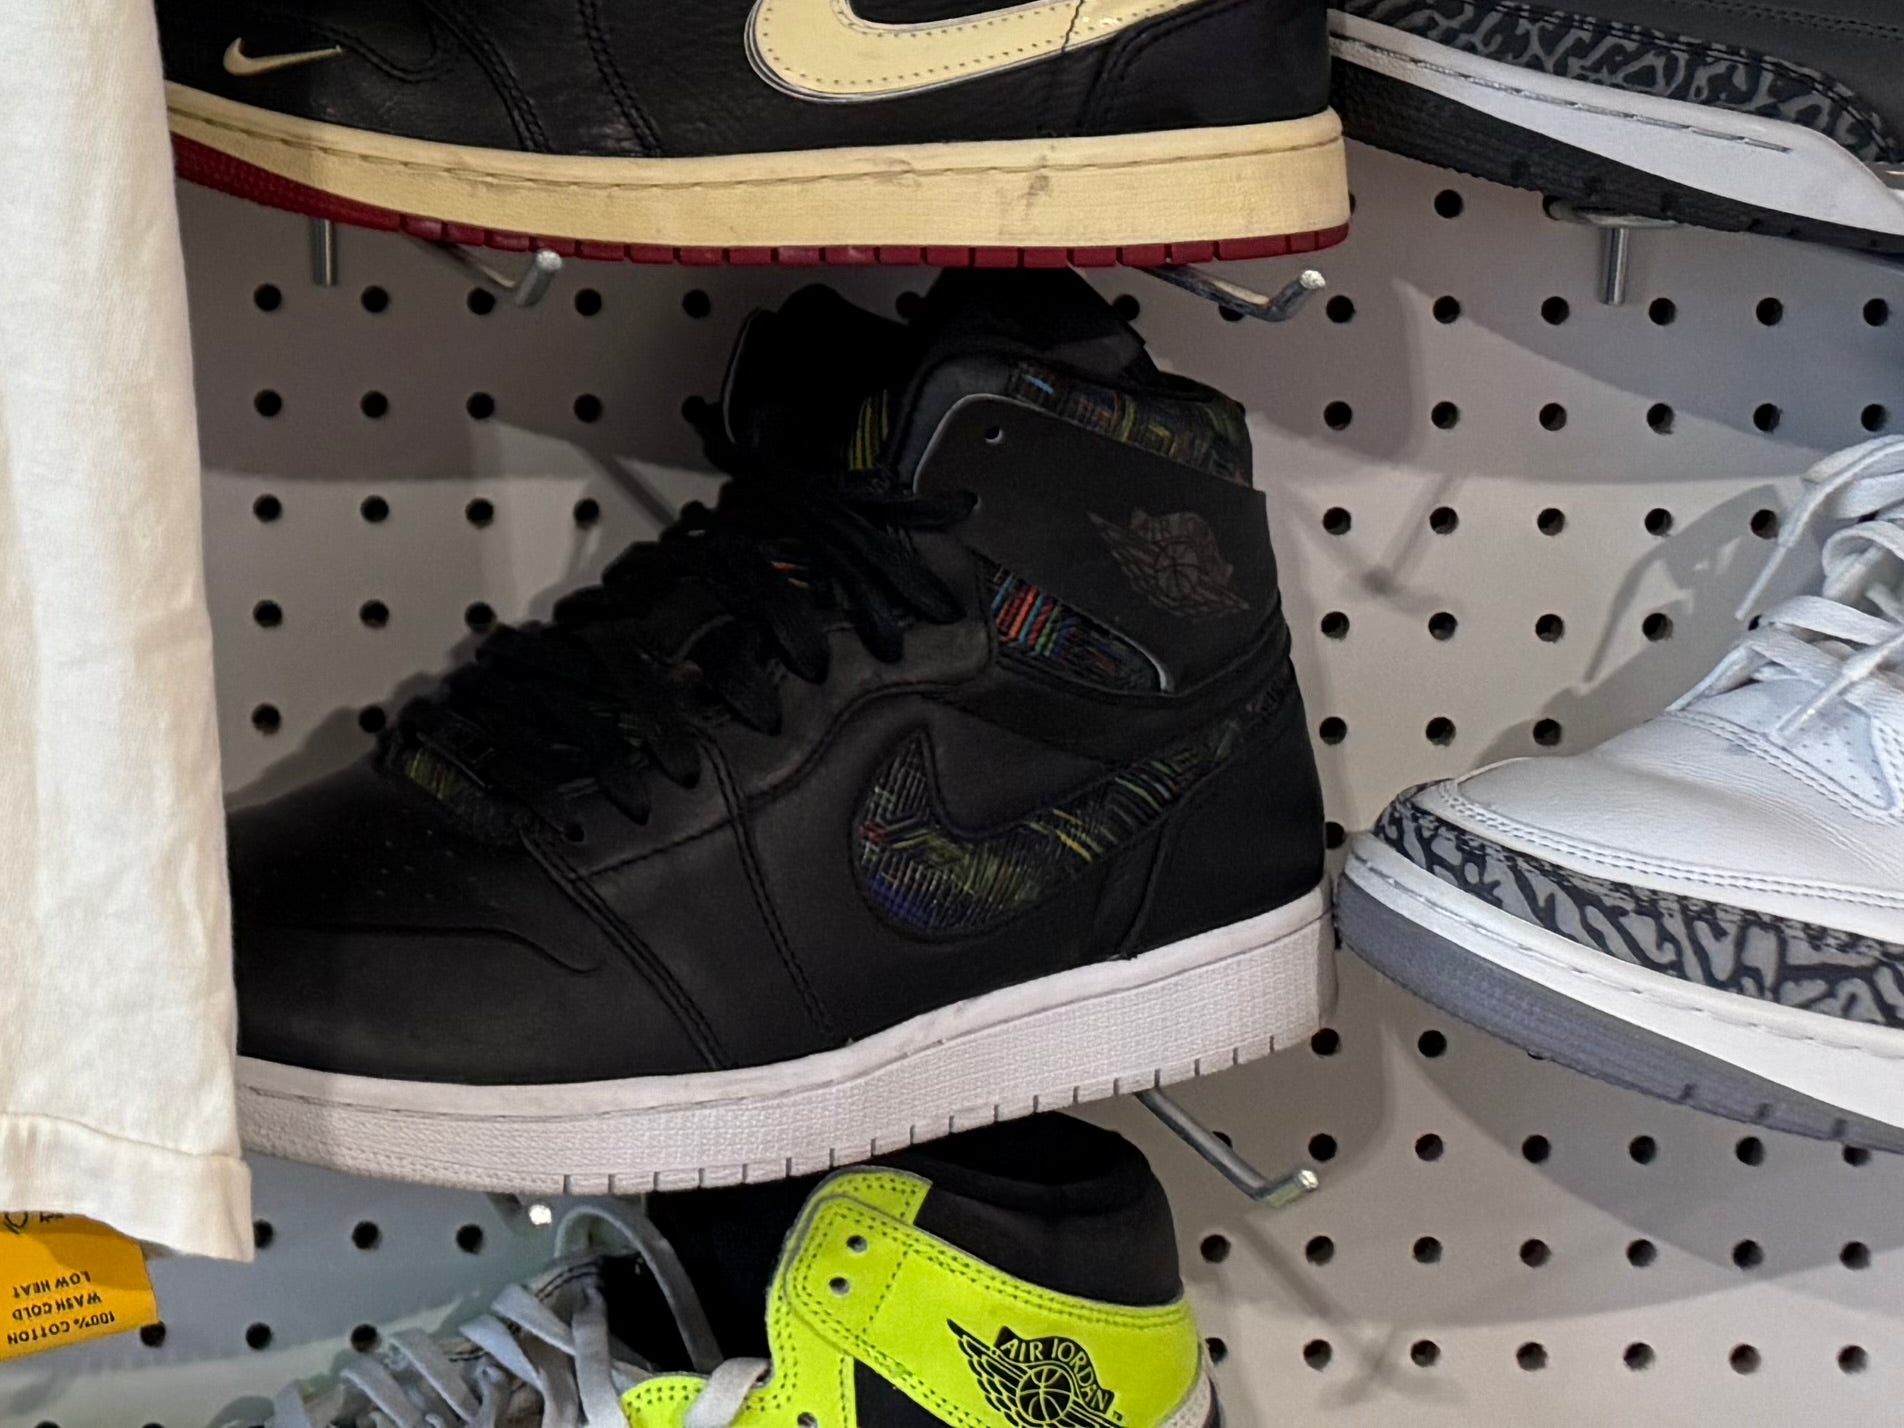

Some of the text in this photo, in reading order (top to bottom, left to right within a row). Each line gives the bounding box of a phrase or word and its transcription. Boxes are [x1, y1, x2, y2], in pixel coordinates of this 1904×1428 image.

[12, 1270, 91, 1299] LOW HEAT
[12, 1291, 102, 1321] WASH COLD
[7, 1310, 116, 1345] 100% COTTON
[1000, 1338, 1044, 1362] AIR
